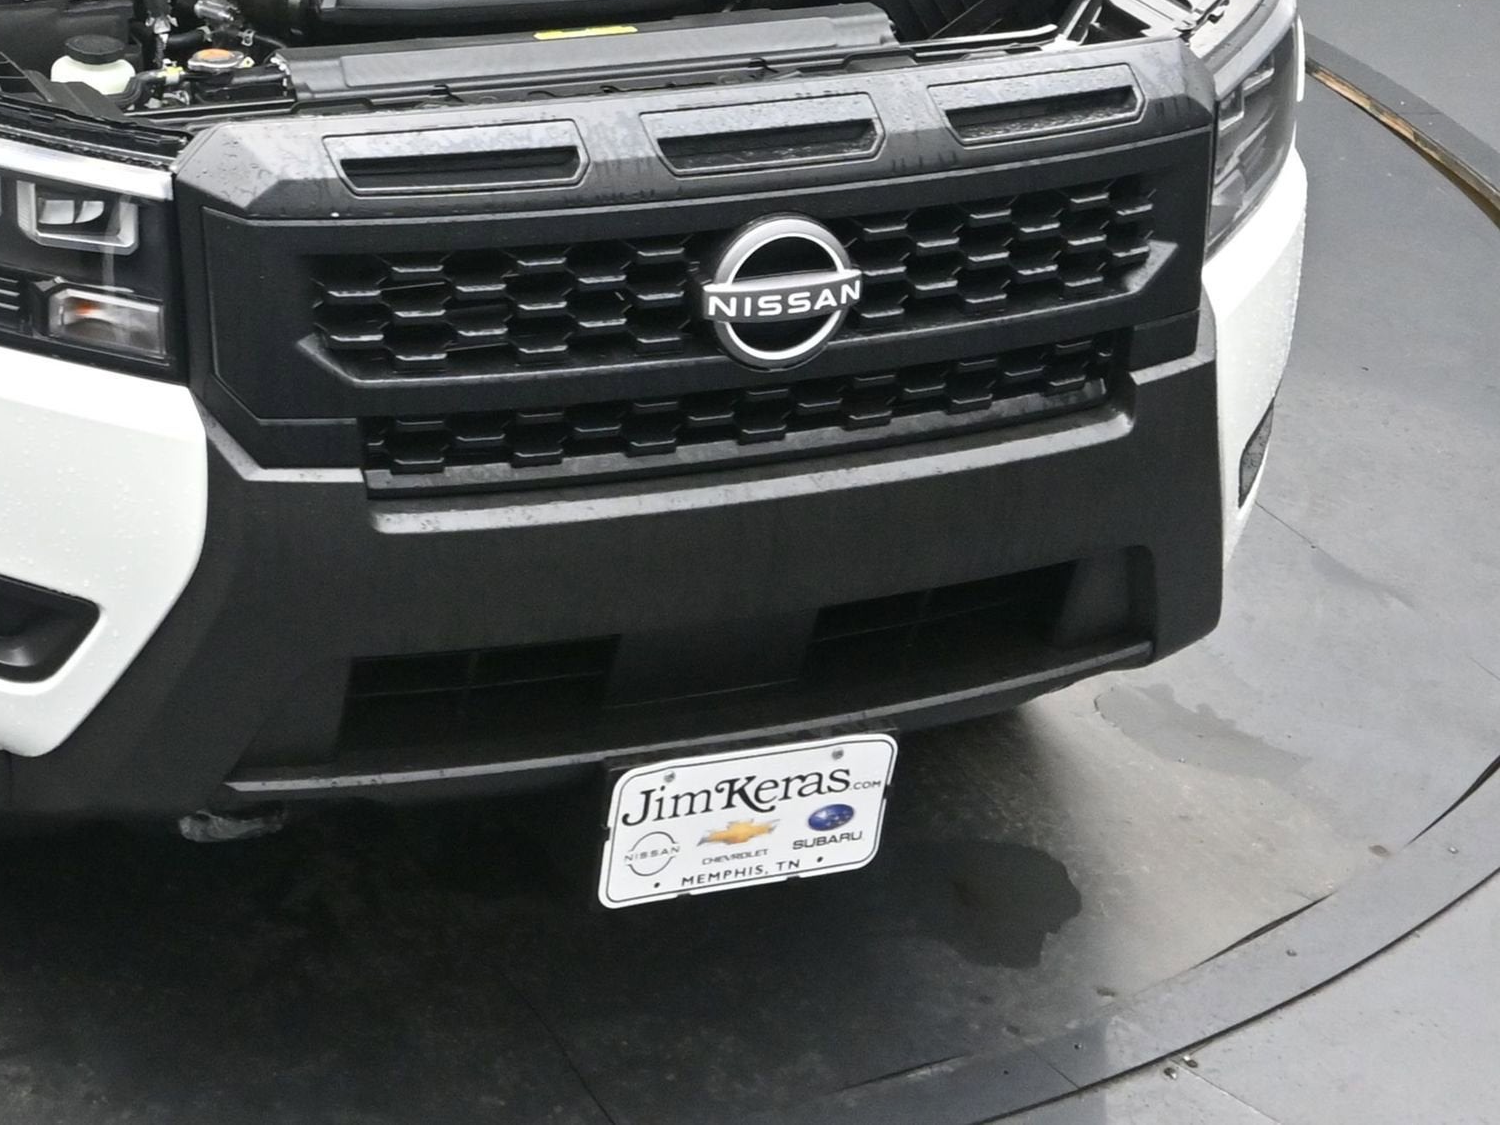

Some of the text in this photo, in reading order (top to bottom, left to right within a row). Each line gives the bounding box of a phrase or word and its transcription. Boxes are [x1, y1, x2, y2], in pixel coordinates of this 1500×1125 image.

[708, 280, 861, 317] NISSAN
[792, 831, 863, 851] SUBARU
[623, 845, 681, 863] NISSAN
[701, 848, 769, 865] CHEVROLET
[681, 859, 801, 887] MEMPHIS, TN
